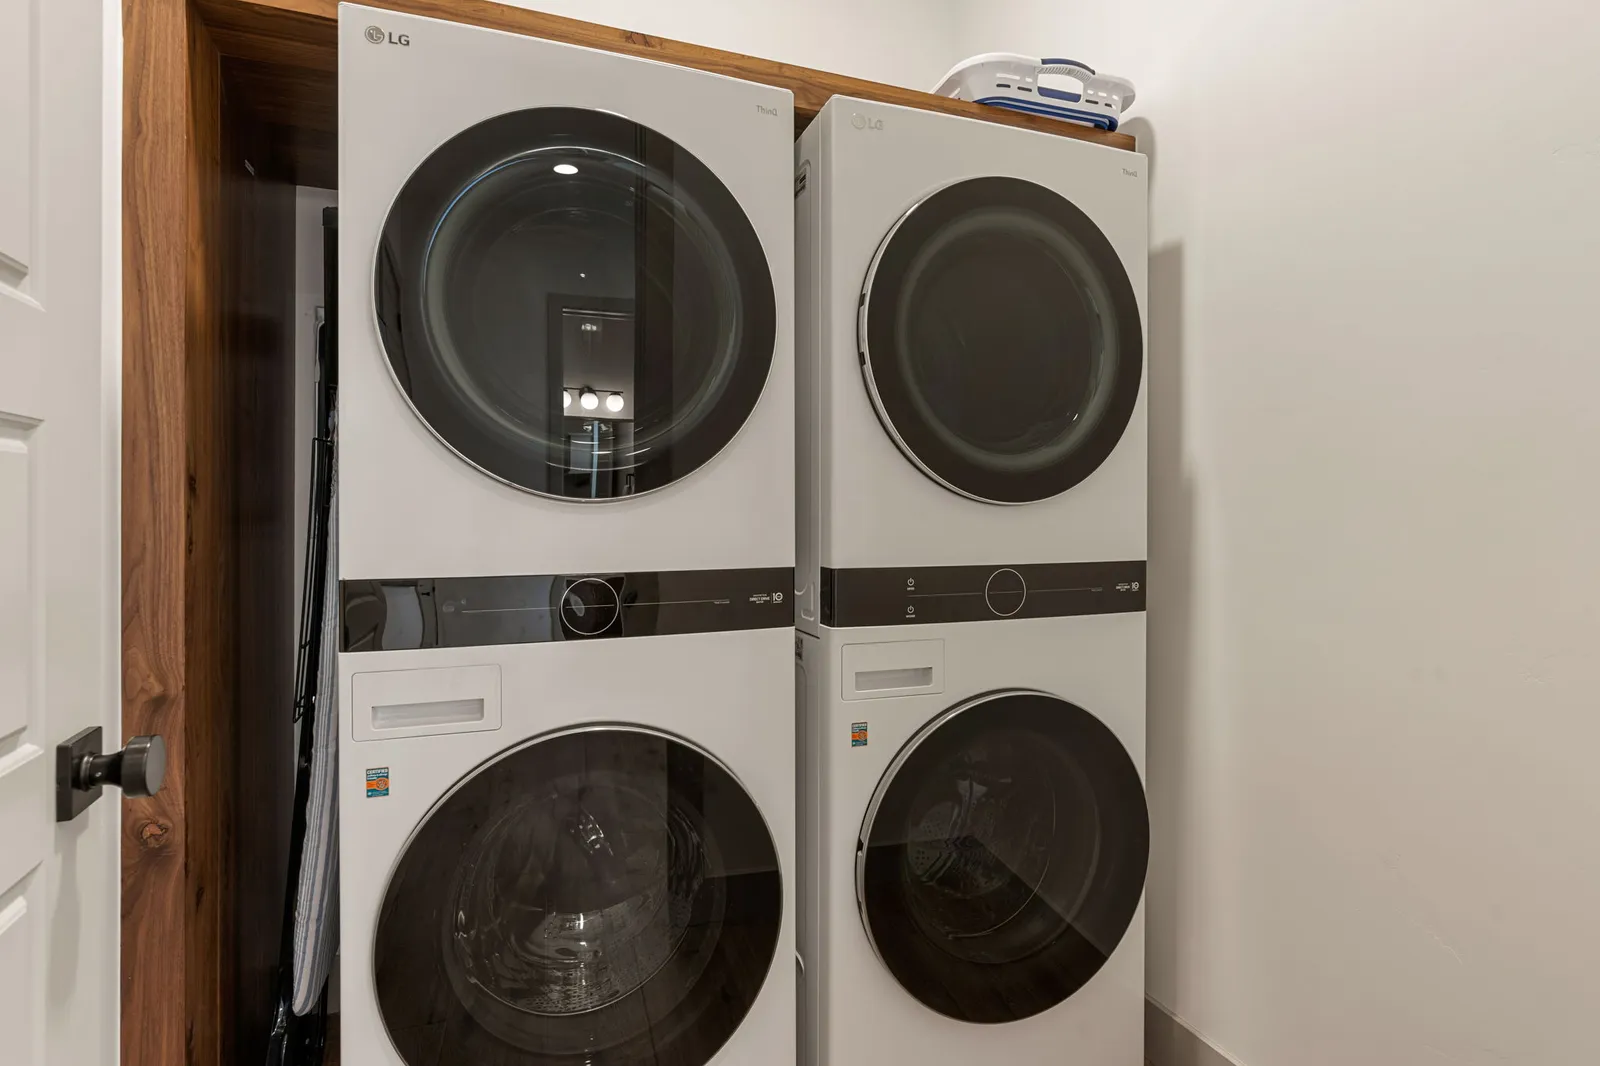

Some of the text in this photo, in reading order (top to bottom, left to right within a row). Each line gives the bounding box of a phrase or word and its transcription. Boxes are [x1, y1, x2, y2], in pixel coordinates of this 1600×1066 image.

[388, 31, 410, 46] LG
[755, 104, 778, 117] ThinQ
[868, 117, 884, 131] LG
